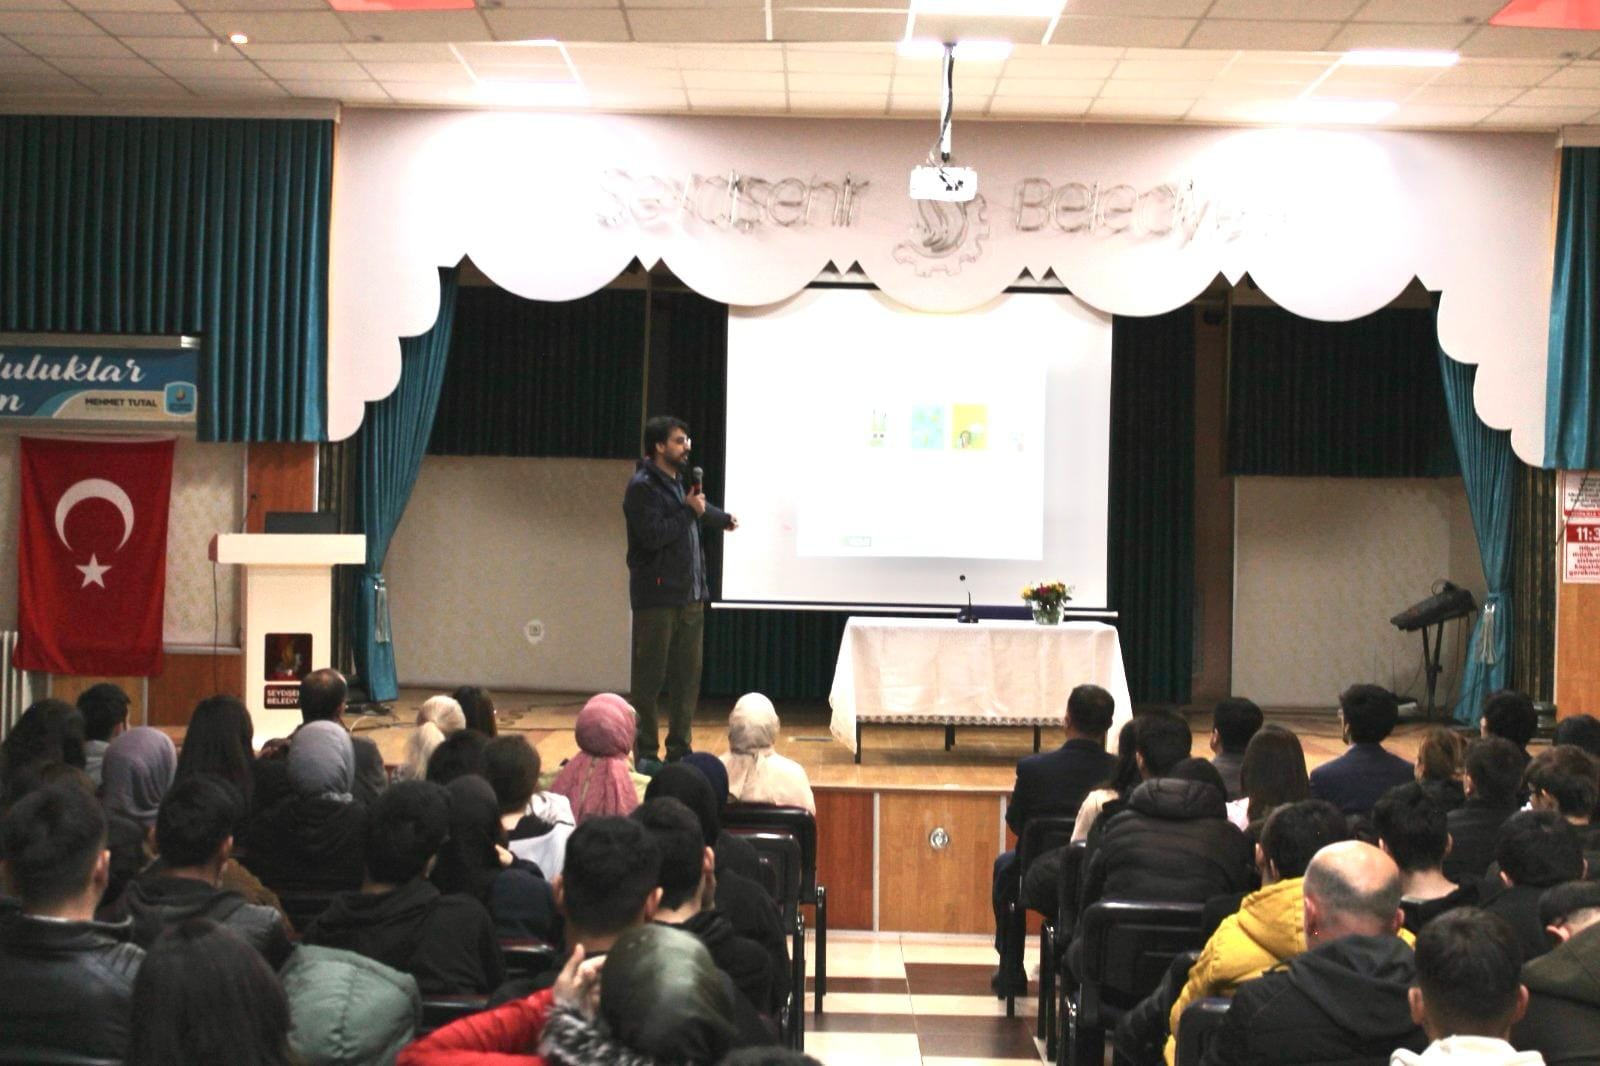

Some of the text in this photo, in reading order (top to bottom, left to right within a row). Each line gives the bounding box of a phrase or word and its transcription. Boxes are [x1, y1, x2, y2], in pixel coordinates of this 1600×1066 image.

[0, 353, 146, 382] uluklar
[85, 397, 124, 407] MEHMET
[128, 398, 157, 409] TUTAL
